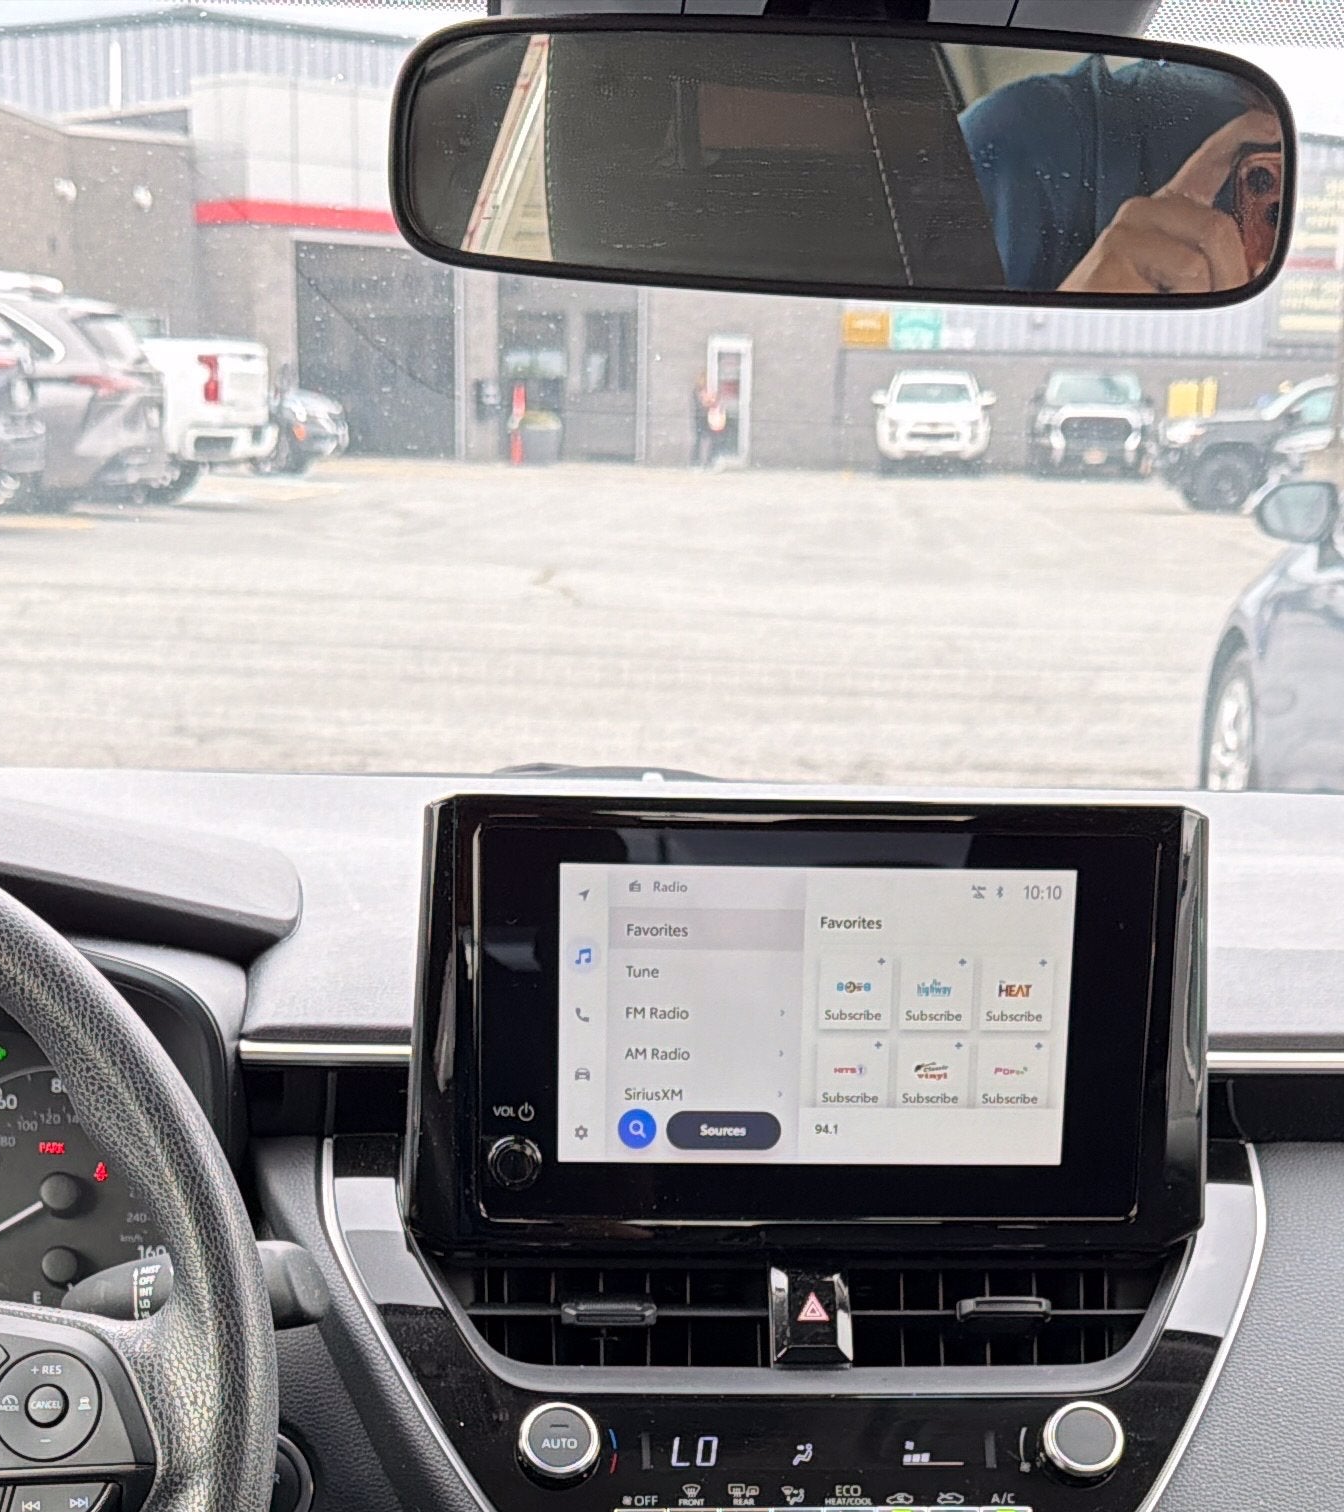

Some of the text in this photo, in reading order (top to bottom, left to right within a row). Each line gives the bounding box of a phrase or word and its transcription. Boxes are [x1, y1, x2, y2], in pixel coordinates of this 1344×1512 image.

[652, 881, 688, 893] Radio
[1023, 885, 1062, 900] 10:10
[820, 916, 883, 930] Favorites
[626, 923, 689, 938] Favorites
[626, 965, 660, 979] Tune
[625, 1006, 690, 1020] FM Radio
[824, 1009, 882, 1021] Subscribe
[905, 1010, 963, 1022] Subscribe
[985, 1011, 1043, 1023] Subscribe
[624, 1048, 691, 1061] AM Radio
[624, 1087, 684, 1102] SiriusXM
[822, 1092, 879, 1104] Subscribe
[902, 1093, 959, 1105] Subscribe
[982, 1094, 1039, 1105] Subscribe
[492, 1104, 516, 1117] VOL
[39, 1113, 61, 1125] 120
[17, 1120, 38, 1132] 100
[699, 1123, 747, 1137] Sources
[814, 1124, 839, 1135] 94.1
[0, 1136, 16, 1148] 80
[38, 1141, 65, 1155] PARK
[126, 1212, 148, 1223] 240
[120, 1233, 143, 1243] km/h
[138, 1275, 156, 1286] OFF
[139, 1286, 154, 1297] INT
[32, 1291, 42, 1305] E
[139, 1298, 151, 1309] LO
[41, 1364, 63, 1375] RES
[30, 1400, 62, 1410] CANCEL
[540, 1438, 578, 1450] AUTO
[670, 1436, 719, 1467] LO
[835, 1484, 862, 1497] ECO
[633, 1495, 659, 1507] OFF
[678, 1498, 705, 1506] FRONT
[732, 1497, 755, 1506] REAR
[824, 1497, 873, 1506] HEAT/COOL
[990, 1492, 1016, 1504] A/C
